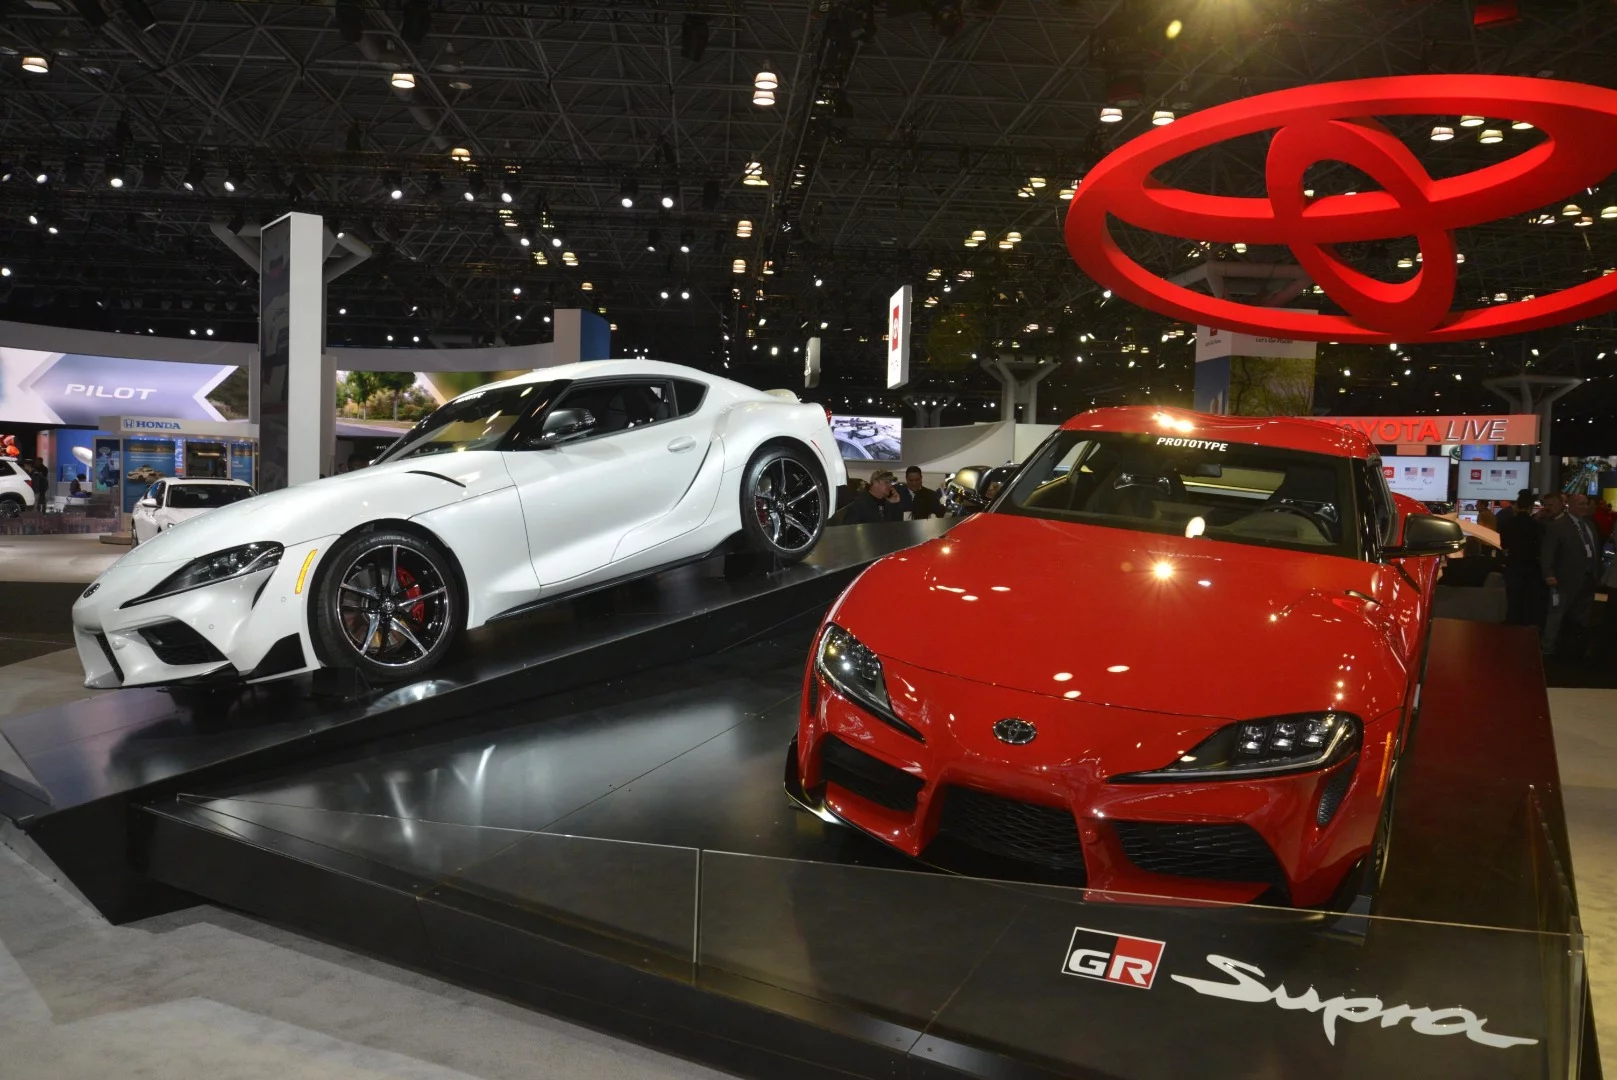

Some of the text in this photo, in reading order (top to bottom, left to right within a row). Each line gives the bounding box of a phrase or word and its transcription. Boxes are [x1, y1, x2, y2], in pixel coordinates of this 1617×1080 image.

[64, 383, 158, 400] PILOT
[136, 420, 181, 430] HONDA
[1320, 418, 1509, 442] YOTA LIVE
[1156, 437, 1229, 452] PROTOTYPE
[1068, 948, 1153, 985] GR
[1170, 954, 1539, 1048] Supra
